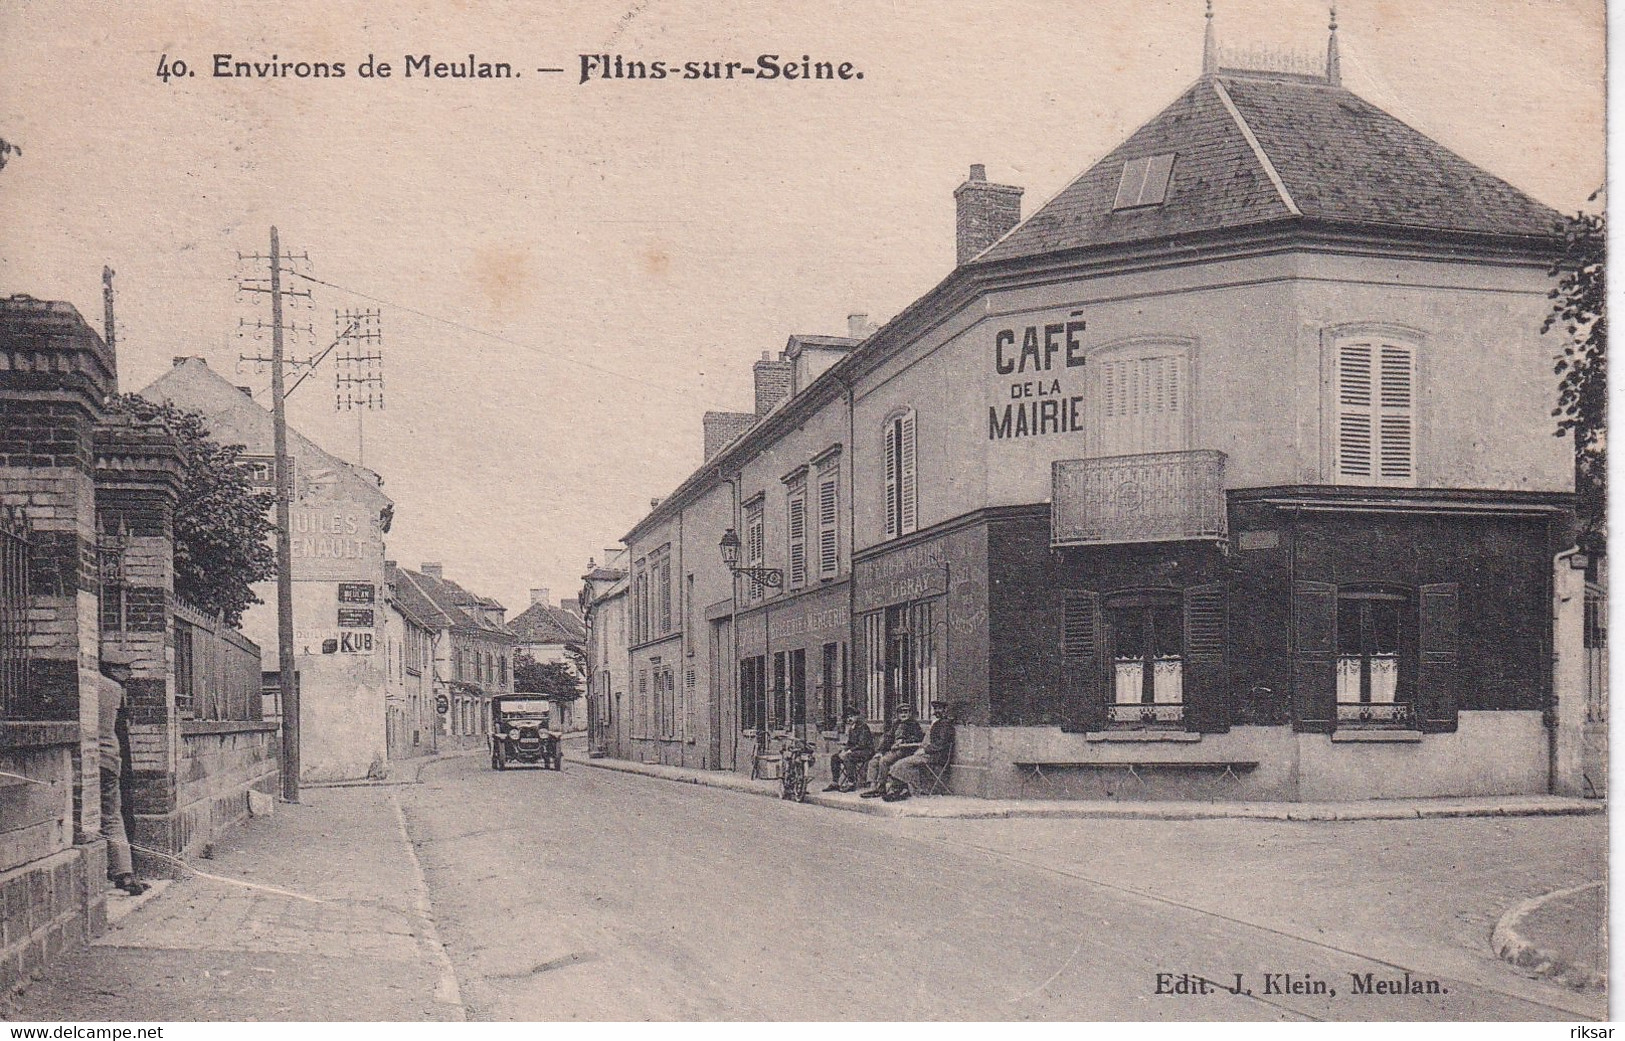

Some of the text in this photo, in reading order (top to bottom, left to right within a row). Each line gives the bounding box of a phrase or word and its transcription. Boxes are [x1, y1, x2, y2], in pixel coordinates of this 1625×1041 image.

[995, 310, 1087, 375] CAFÉ
[1011, 378, 1061, 399] DE LA
[989, 393, 1084, 441] MAIRIE
[340, 631, 373, 653] KUB
